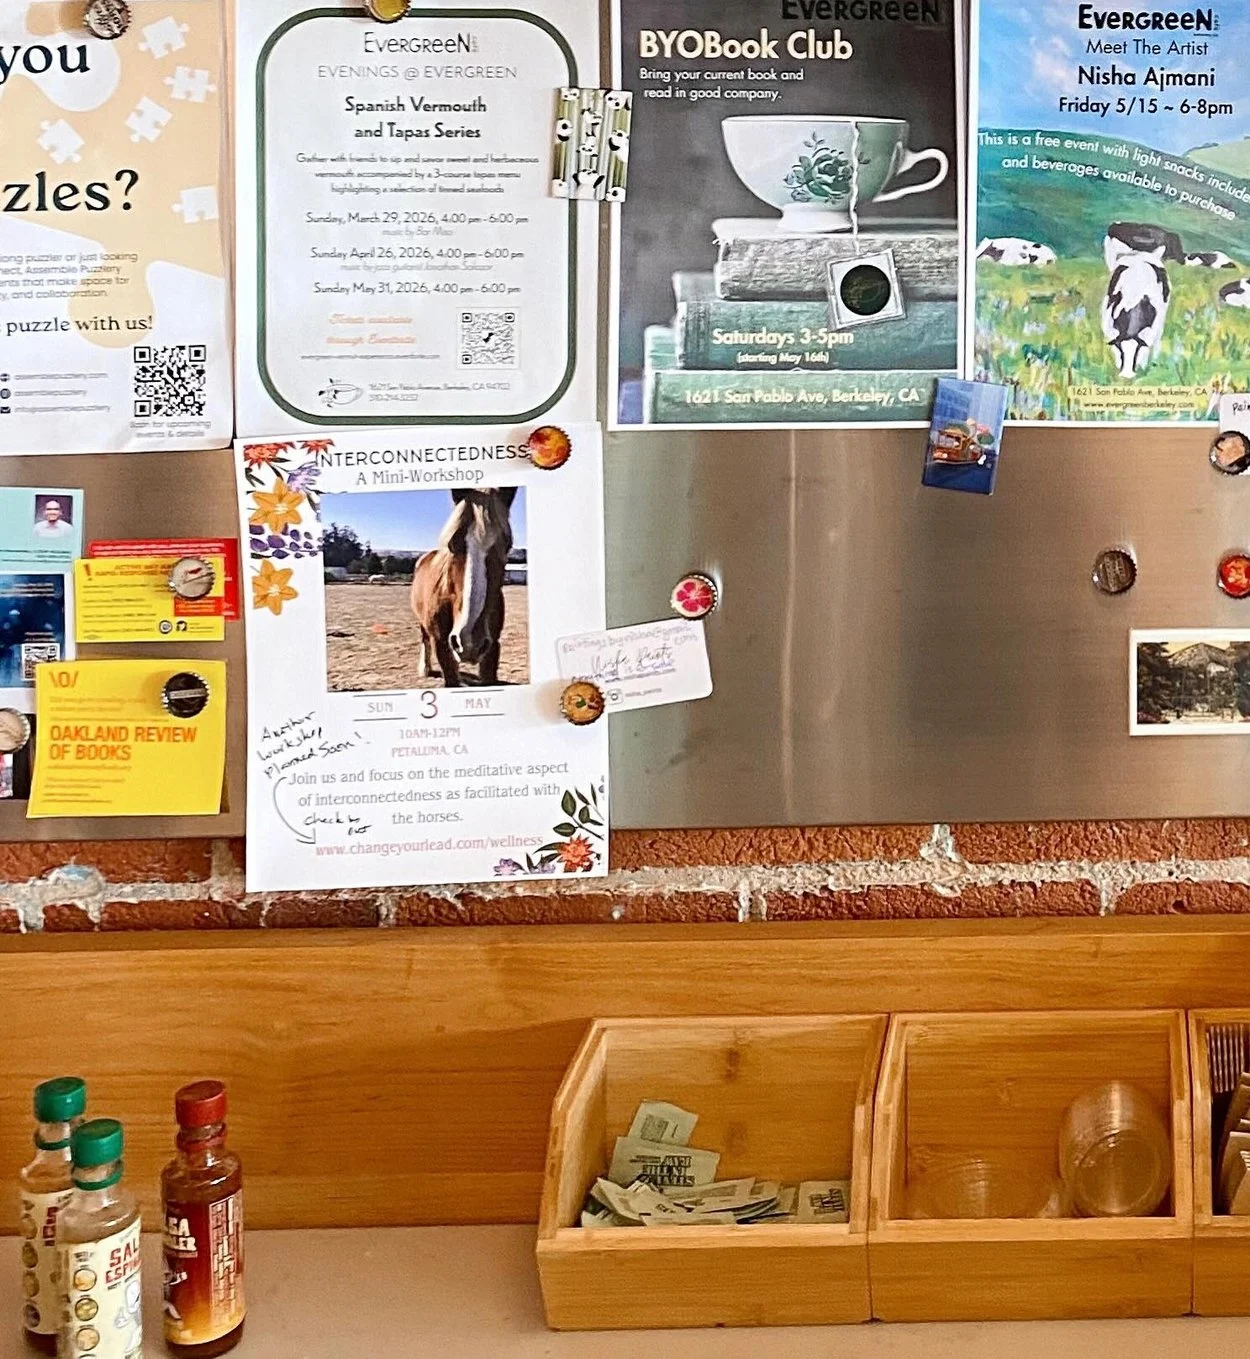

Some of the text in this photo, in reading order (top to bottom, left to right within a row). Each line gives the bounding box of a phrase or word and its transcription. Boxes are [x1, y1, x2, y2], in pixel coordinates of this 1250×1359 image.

[639, 28, 853, 59] BYOBook Club
[1086, 39, 1208, 55] Meet The Artist
[318, 66, 517, 80] EVENINGS @ EVERGREEN
[639, 68, 804, 83] Bring your current book and
[1079, 65, 1215, 91] Nisha Ajmani
[644, 87, 782, 101] read in good company.
[345, 96, 486, 115] Spanish Vermouth
[1059, 96, 1111, 117] Friday
[1116, 97, 1158, 115] 5/15
[1180, 99, 1232, 118] 6-8pm
[355, 122, 480, 141] and Tapas Series
[977, 133, 1003, 146] This
[1008, 133, 1019, 145] is
[1022, 136, 1031, 146] a
[1035, 132, 1060, 147] free
[1064, 138, 1100, 153] event
[1103, 143, 1130, 159] with
[1132, 147, 1162, 167] light
[1164, 159, 1205, 183] snacks
[1002, 156, 1236, 221] and beverages available to purchase
[7, 315, 153, 336] puzzle with us!
[712, 328, 854, 348] Saturdays 3-5pm
[686, 389, 919, 406] 1621 San Pablo Ave, Berkeley, CA
[1072, 388, 1092, 396] 1621
[1096, 388, 1111, 396] San
[1113, 388, 1135, 396] Pablo
[1158, 388, 1192, 397] Berkeley,
[315, 445, 530, 467] INTERCONNECTEDNESS
[356, 469, 484, 485] A Mini-Workshop
[368, 691, 491, 719] SUN 3 MAY
[50, 726, 197, 743] OAKLAND REVIEW
[400, 728, 461, 739] 10AM-12PM
[50, 744, 131, 760] OF BOOKS
[392, 744, 468, 758] PETALUMA, CA
[288, 761, 569, 786] Join us and focus on the meditative aspect
[298, 783, 561, 807] of interconnectedness as facilitated with
[392, 809, 464, 824] the horses.
[316, 834, 544, 856] www.changeyourlead.com/wellness
